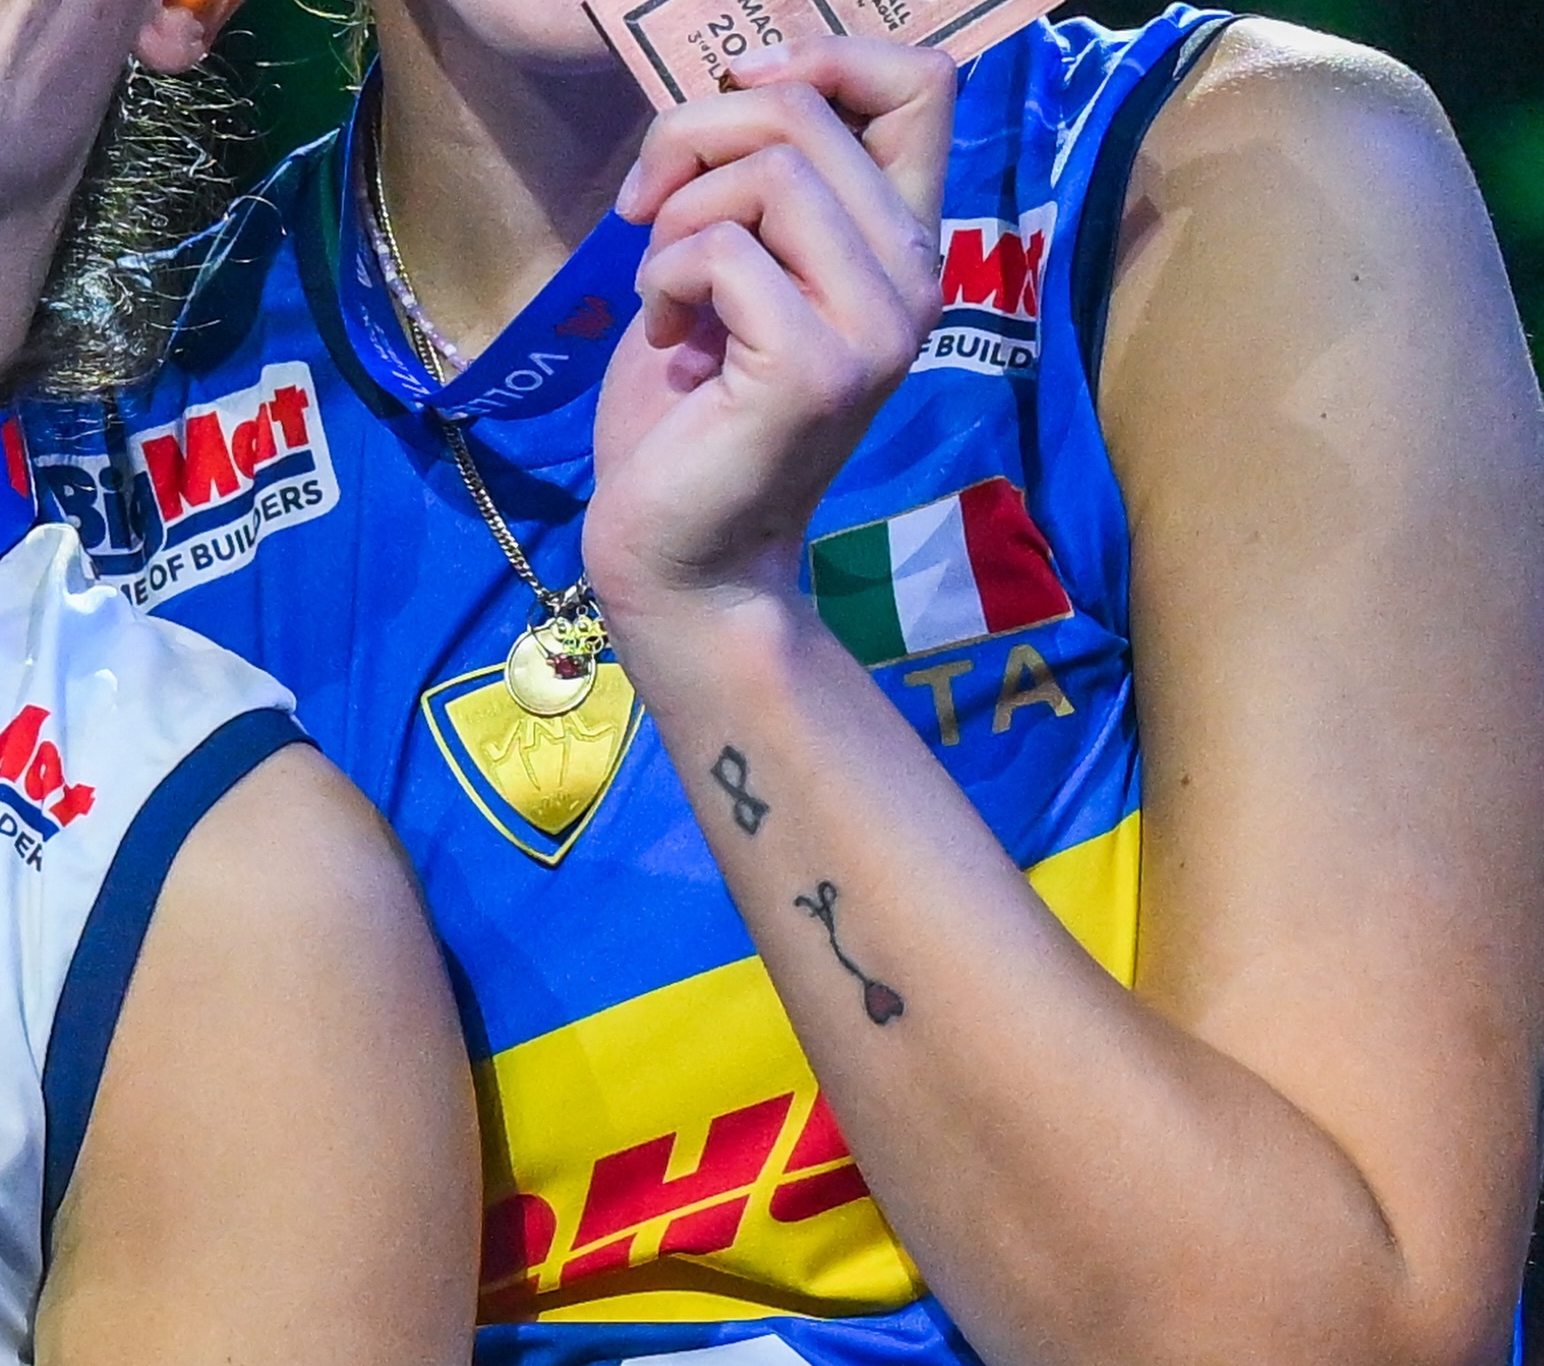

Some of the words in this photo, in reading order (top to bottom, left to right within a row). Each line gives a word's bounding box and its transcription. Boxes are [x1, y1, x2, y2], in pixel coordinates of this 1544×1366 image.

[707, 14, 747, 56] 20
[934, 334, 1034, 369] BUILD
[149, 554, 184, 590] OF
[903, 643, 1076, 746] TA
